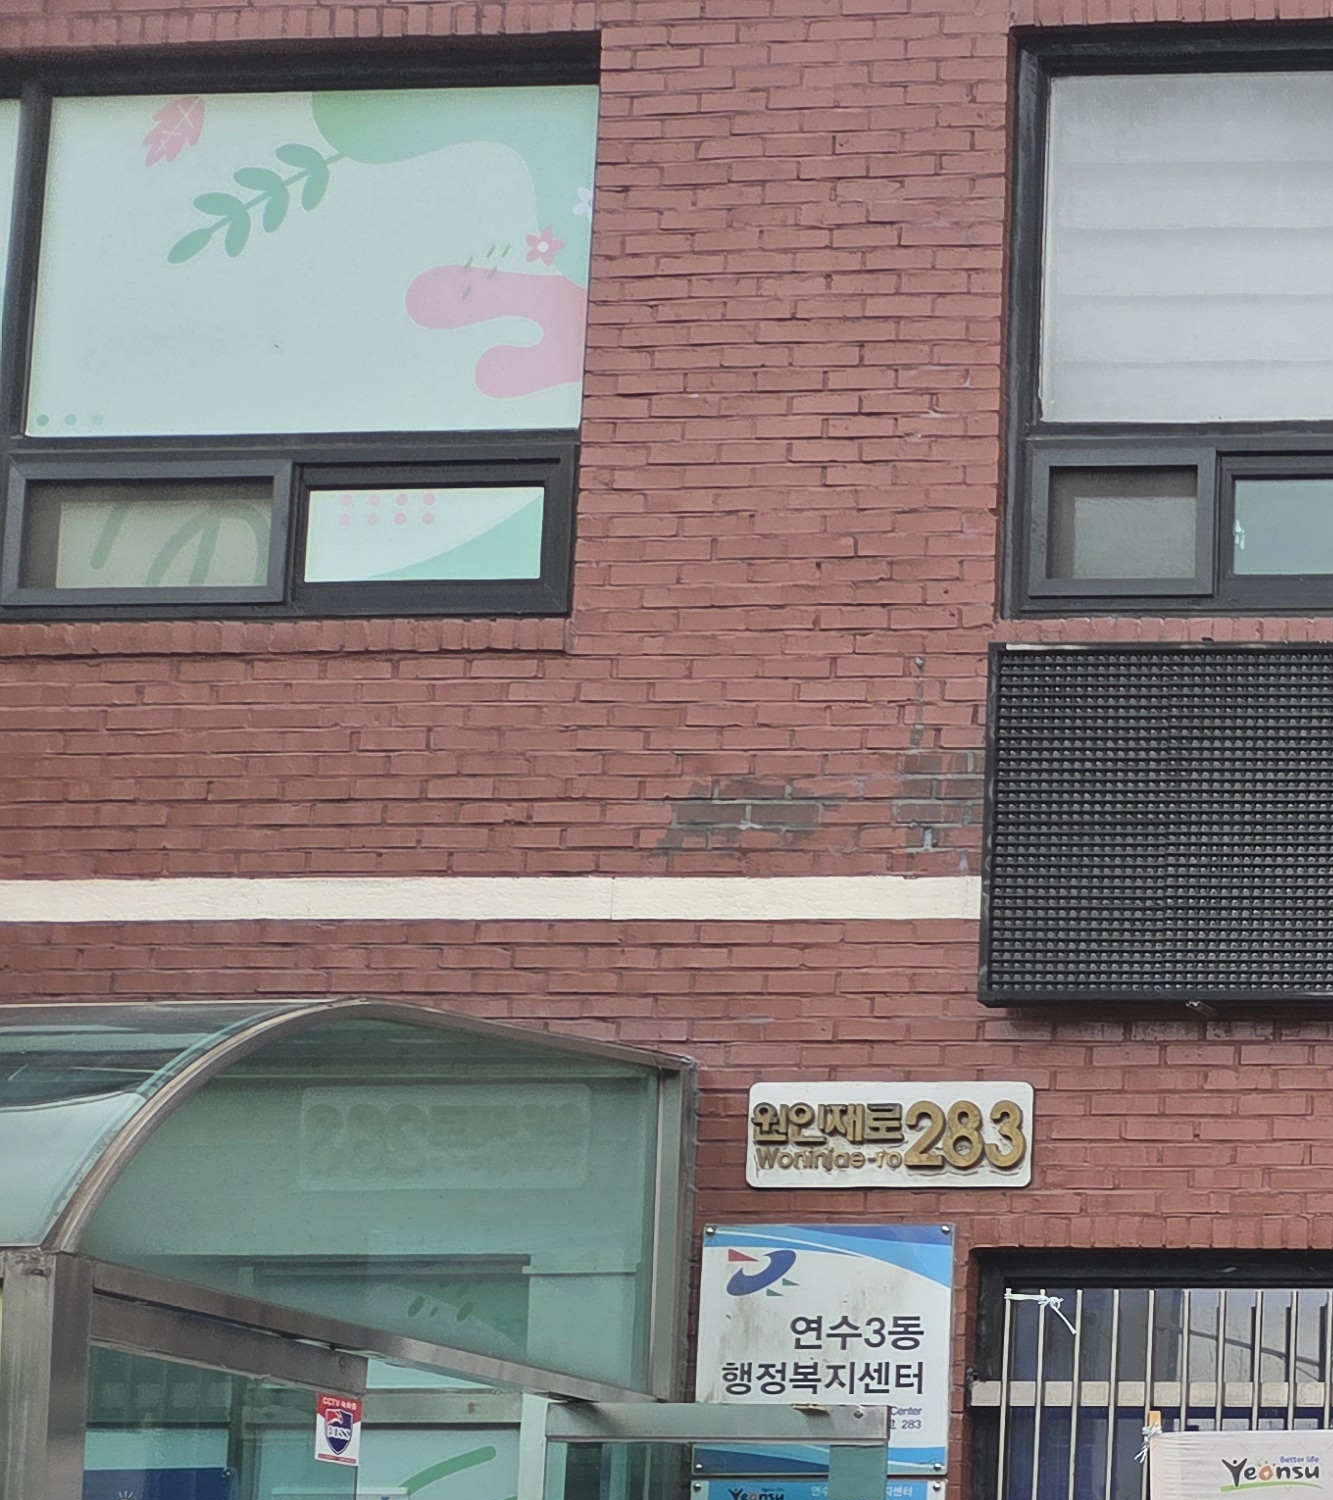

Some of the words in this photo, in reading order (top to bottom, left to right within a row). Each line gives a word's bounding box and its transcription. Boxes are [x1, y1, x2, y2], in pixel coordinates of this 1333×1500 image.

[752, 1102, 903, 1144] 원인재로
[904, 1099, 1026, 1169] 283
[757, 1148, 903, 1171] Woninjae-ro
[790, 1315, 925, 1350] 연수3동
[722, 1361, 924, 1395] 행정복지센터
[902, 1420, 921, 1429] 283
[1221, 1458, 1320, 1488] Yeonsu
